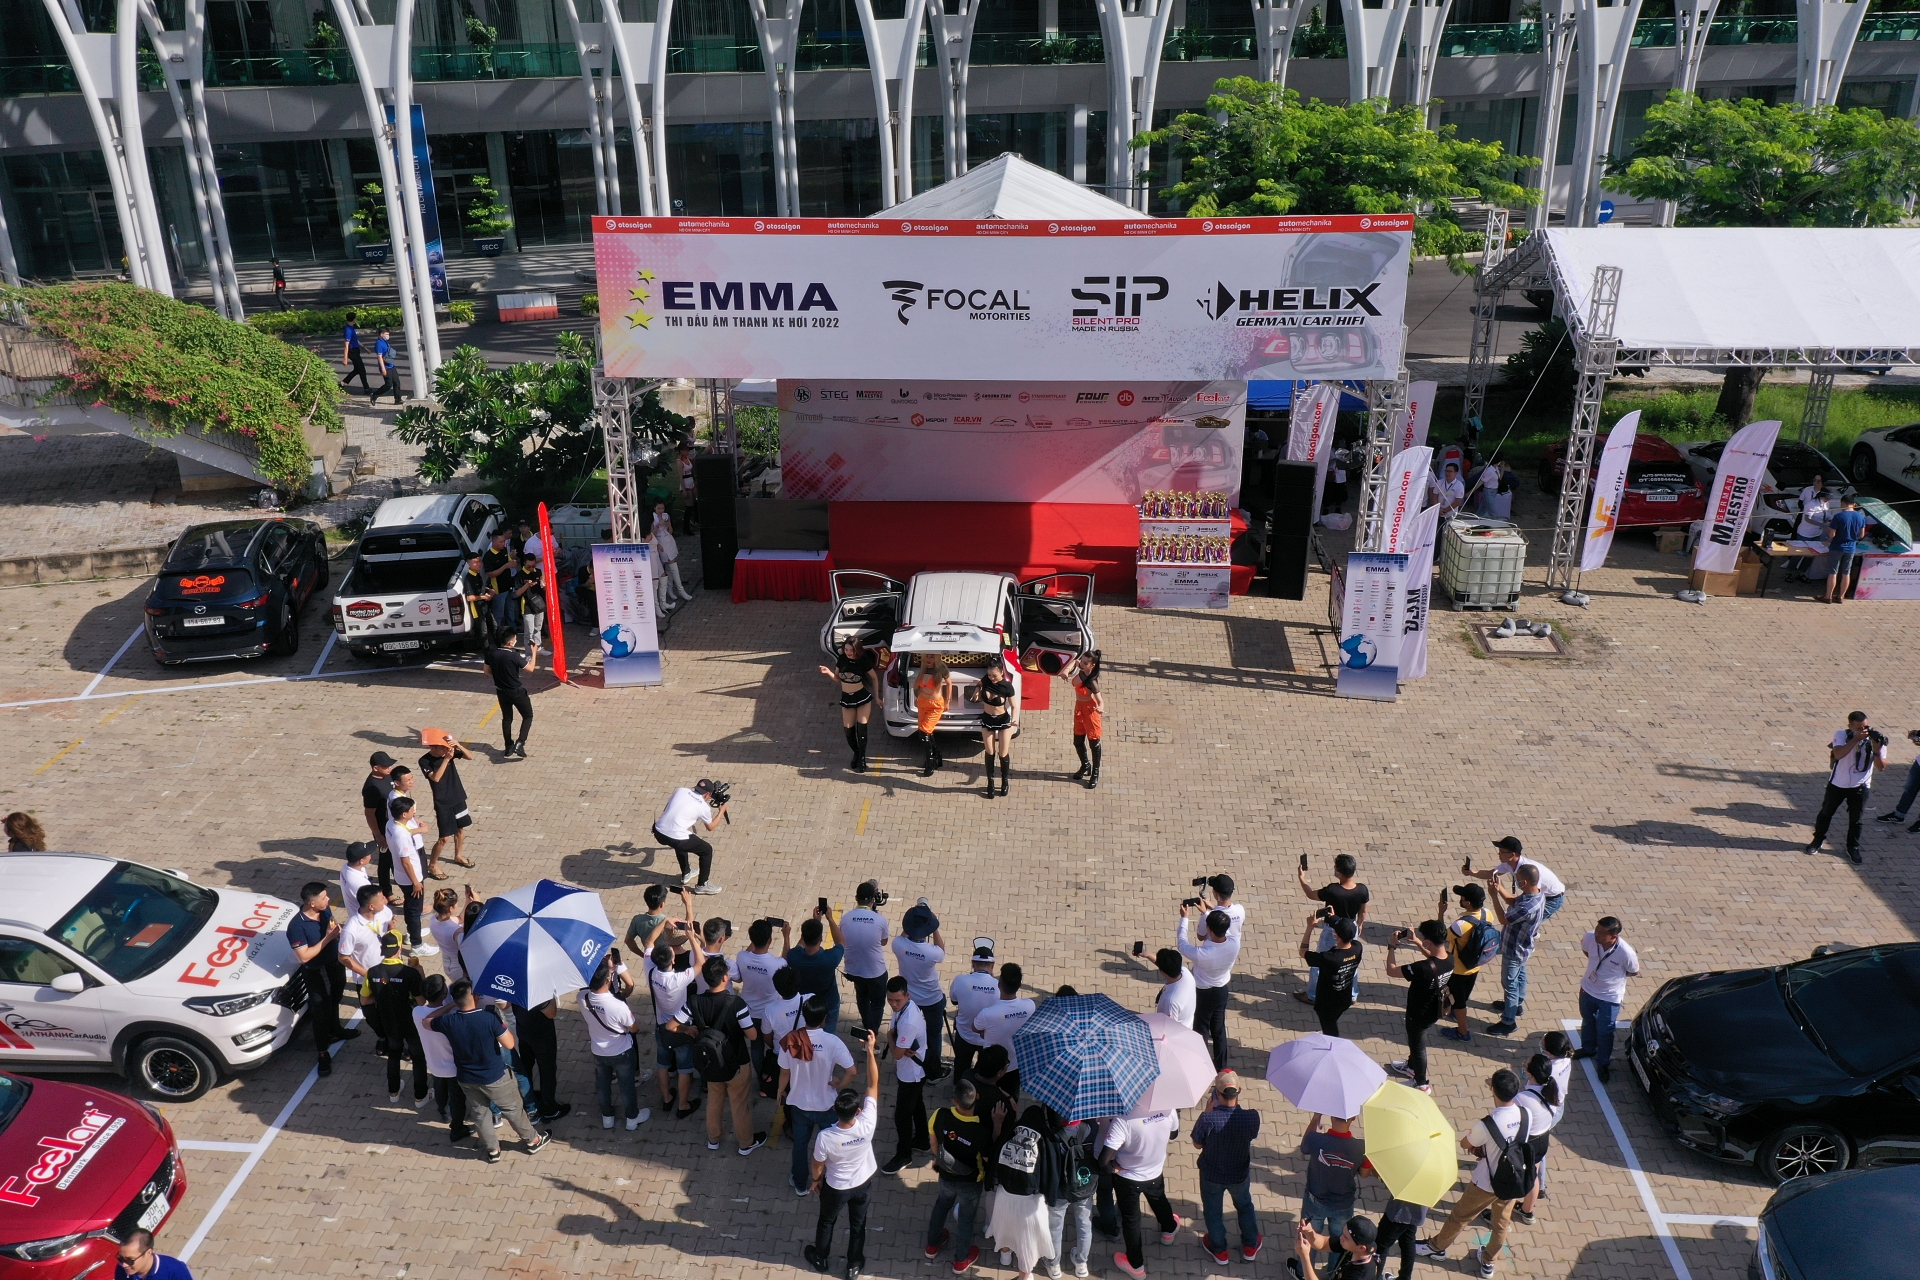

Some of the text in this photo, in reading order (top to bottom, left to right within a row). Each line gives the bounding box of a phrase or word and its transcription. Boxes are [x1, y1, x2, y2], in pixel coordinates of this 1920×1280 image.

[618, 222, 652, 230] otosaigon
[766, 223, 801, 232] otosaigon
[1123, 222, 1177, 230] automechanika
[1214, 222, 1251, 230] otosaigon
[1278, 219, 1332, 227] automechanika
[1373, 219, 1409, 227] otosaigon
[913, 224, 949, 232] otosaigon
[481, 243, 500, 251] SECC
[365, 250, 384, 258] SECC
[662, 281, 839, 311] EMMA
[927, 289, 1030, 310] FOCAL
[1239, 282, 1383, 316] HELIX
[665, 312, 840, 328] THI ĐẤU ÂM THANH XE HƠI 2022
[969, 312, 1031, 321] MOTORITIES
[1072, 317, 1140, 325] SILENT PRO
[1236, 316, 1366, 327] GERMAN CAR HIFI
[820, 391, 849, 399] STEG
[856, 390, 883, 399] MAESTRO
[1119, 393, 1132, 402] db
[1716, 477, 1735, 520] GERMAN
[1710, 477, 1749, 546] MAESTRO
[348, 618, 449, 631] RANGER
[177, 901, 280, 988] Feelart
[229, 941, 266, 981] Denmark
[265, 921, 283, 937] Since
[904, 950, 926, 958] EMMA
[746, 965, 768, 973] EMMA
[490, 984, 516, 995] SUBARU
[1004, 1010, 1028, 1019] EMMA
[1142, 1112, 1164, 1124] EMMA
[841, 1137, 866, 1147] EMMA
[0, 1108, 112, 1207] Feelart
[58, 1117, 126, 1189] Denmark Since 1996
